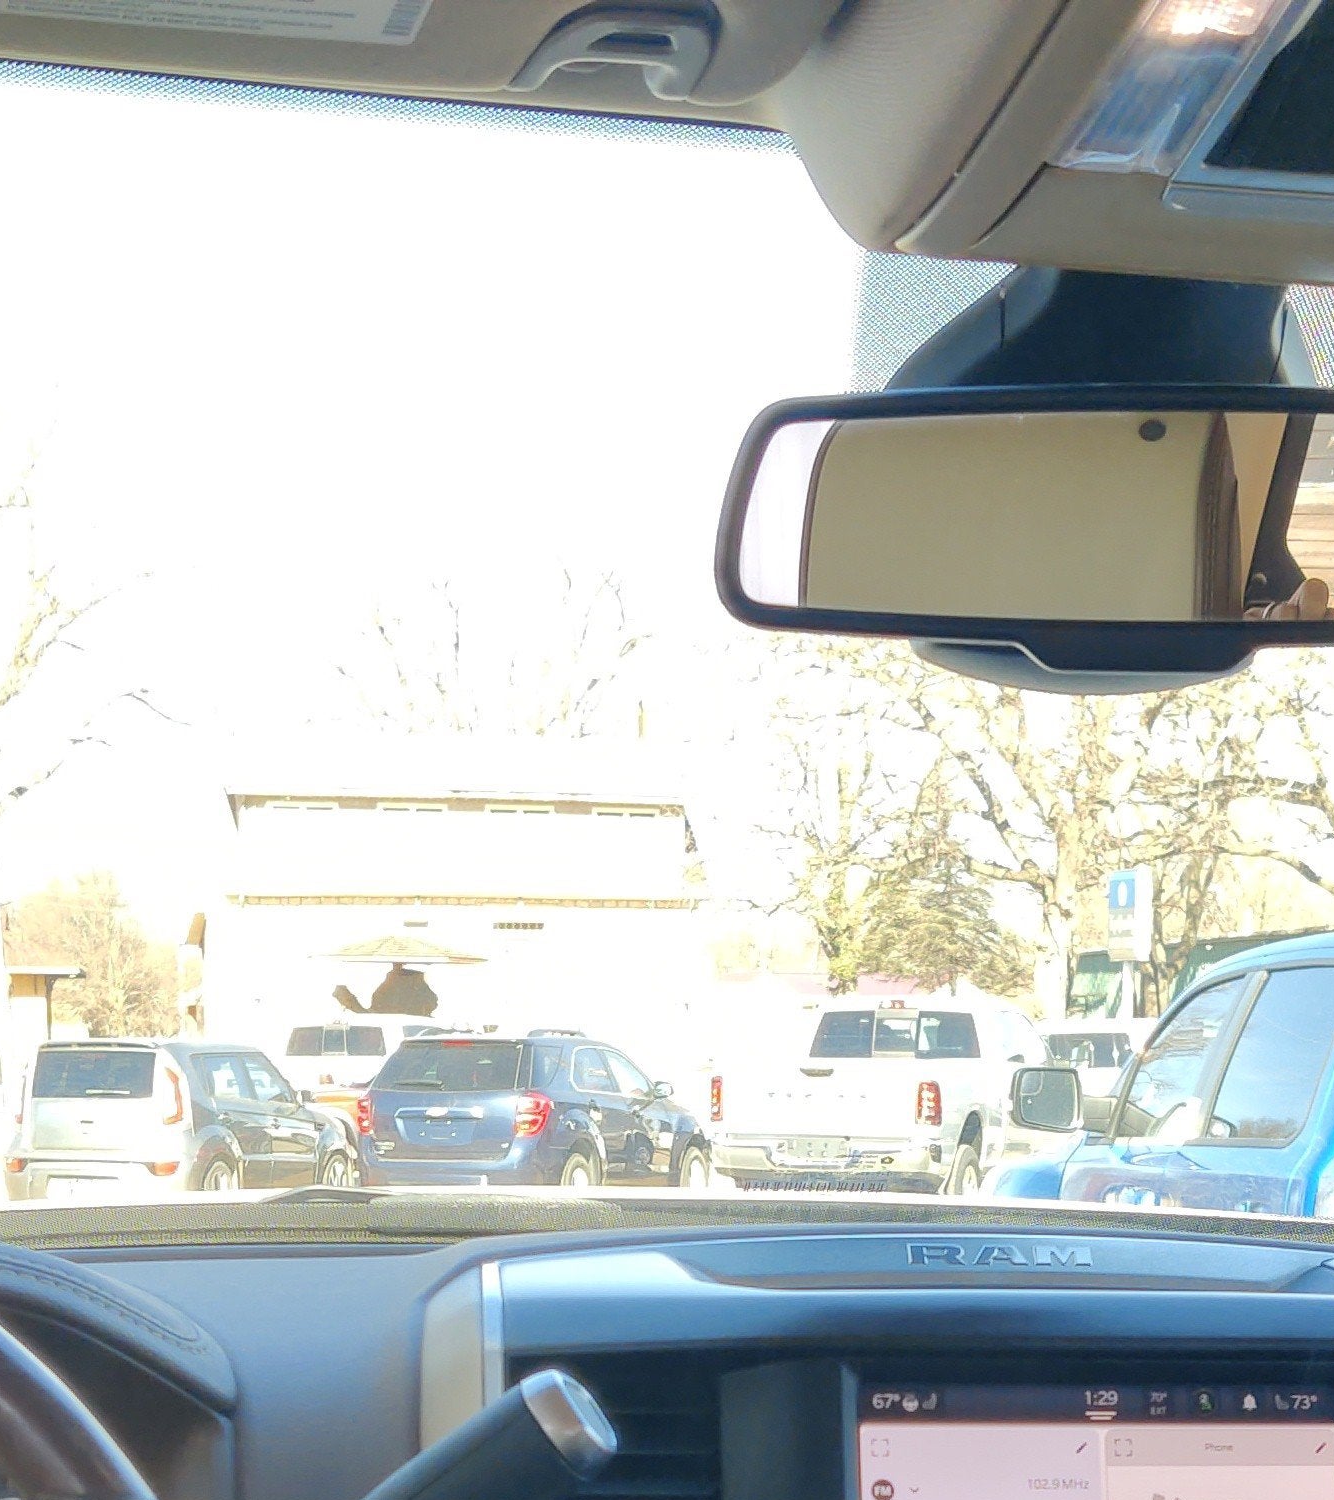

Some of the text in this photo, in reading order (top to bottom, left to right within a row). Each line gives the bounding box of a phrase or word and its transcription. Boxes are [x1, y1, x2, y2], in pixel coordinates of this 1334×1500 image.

[906, 1243, 1094, 1267] RAM
[1084, 1390, 1118, 1406] 1:29
[1204, 1443, 1234, 1452] Phone
[1028, 1478, 1090, 1490] 102.9 MHz
